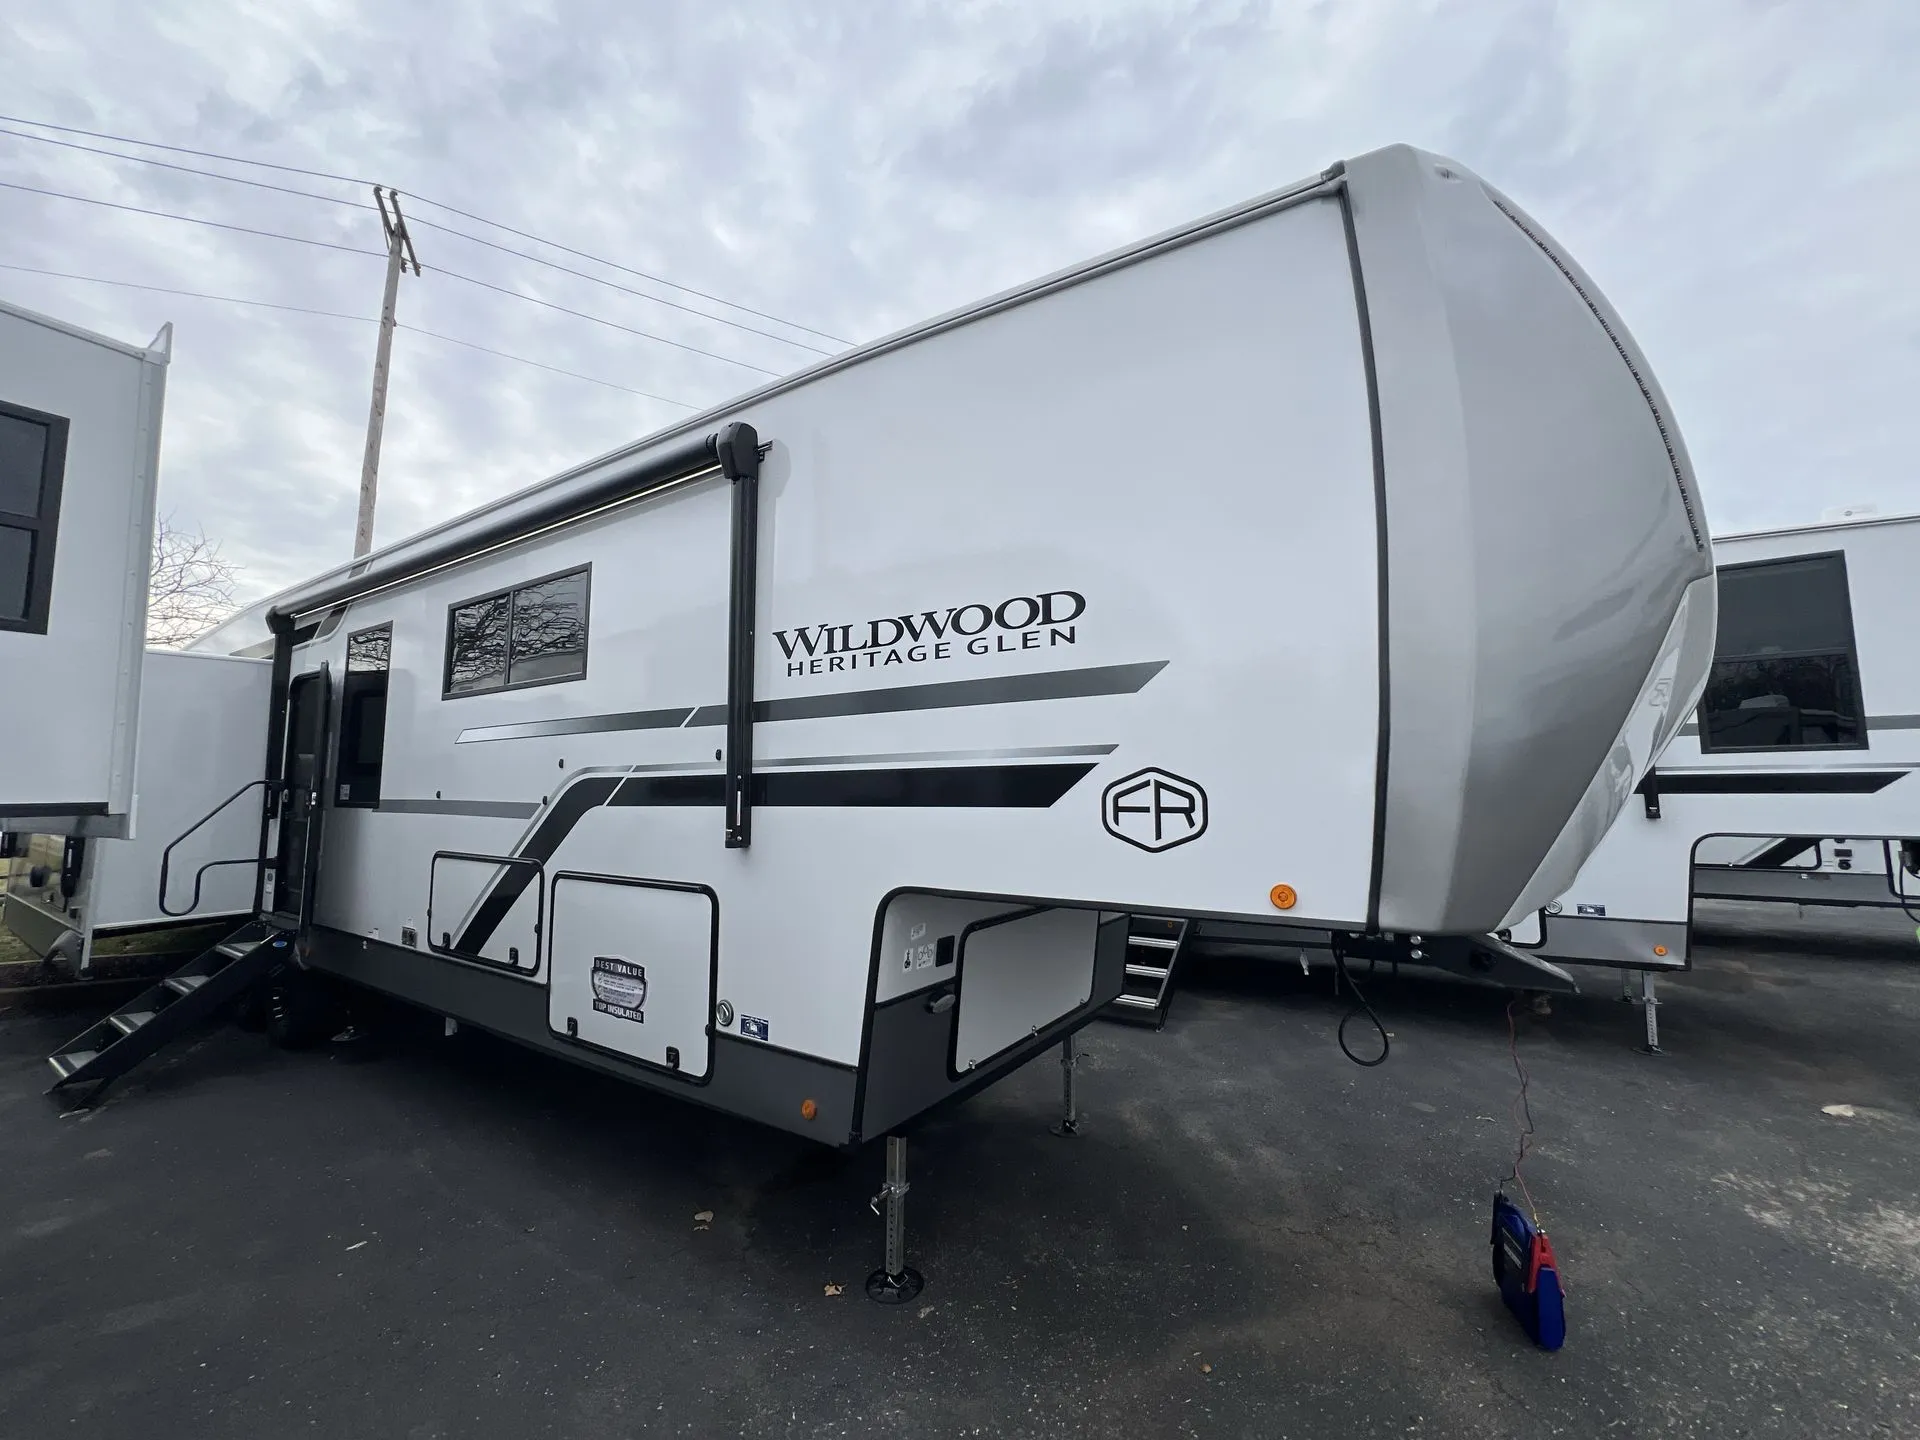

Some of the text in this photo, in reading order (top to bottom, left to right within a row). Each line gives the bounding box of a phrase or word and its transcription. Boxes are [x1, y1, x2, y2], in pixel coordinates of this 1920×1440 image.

[772, 591, 1087, 660] WILDWOOD
[787, 626, 1076, 678] HERITAGE GLEN
[596, 960, 642, 976] BEST VALUE
[595, 1001, 641, 1020] TOP INSULATED
